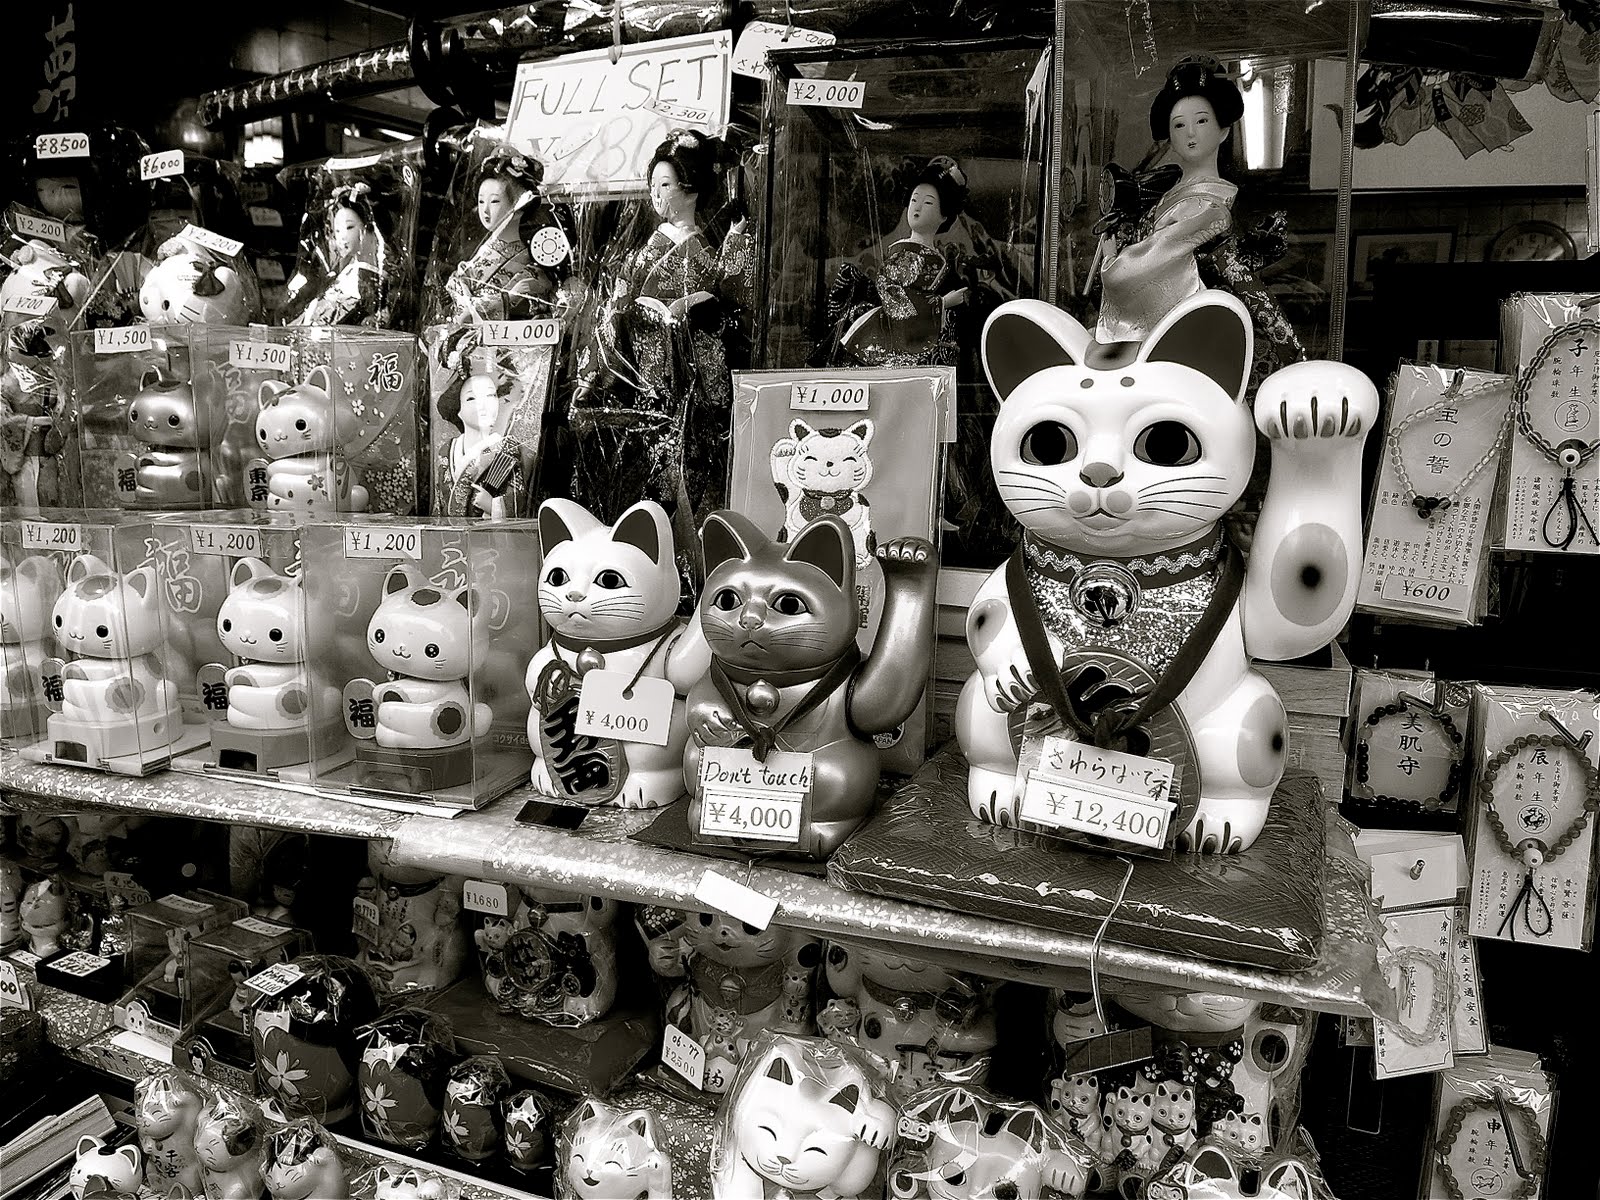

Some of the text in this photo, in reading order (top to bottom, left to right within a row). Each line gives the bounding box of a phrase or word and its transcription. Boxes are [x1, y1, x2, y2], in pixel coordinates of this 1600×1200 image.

[515, 55, 718, 120] FULL SET
[793, 82, 860, 103] ¥2,000
[18, 216, 62, 238] ¥2,200
[187, 226, 239, 252] ¥2,200
[97, 329, 148, 349] ¥1,500
[488, 324, 556, 344] ¥1,000
[235, 343, 287, 365] ¥1,500
[366, 352, 405, 393] 福
[795, 385, 865, 405] ¥1,000
[25, 524, 77, 546] ¥1,200
[195, 529, 257, 551] ¥1,200
[350, 531, 417, 554] ¥1,200
[1402, 579, 1451, 601] ¥600
[202, 682, 229, 711] 福
[349, 698, 376, 729] 福
[1396, 712, 1424, 777] 美肌守
[703, 760, 810, 788] Don't touch
[707, 802, 793, 830] ¥4,000
[1046, 790, 1163, 839] ¥12,400
